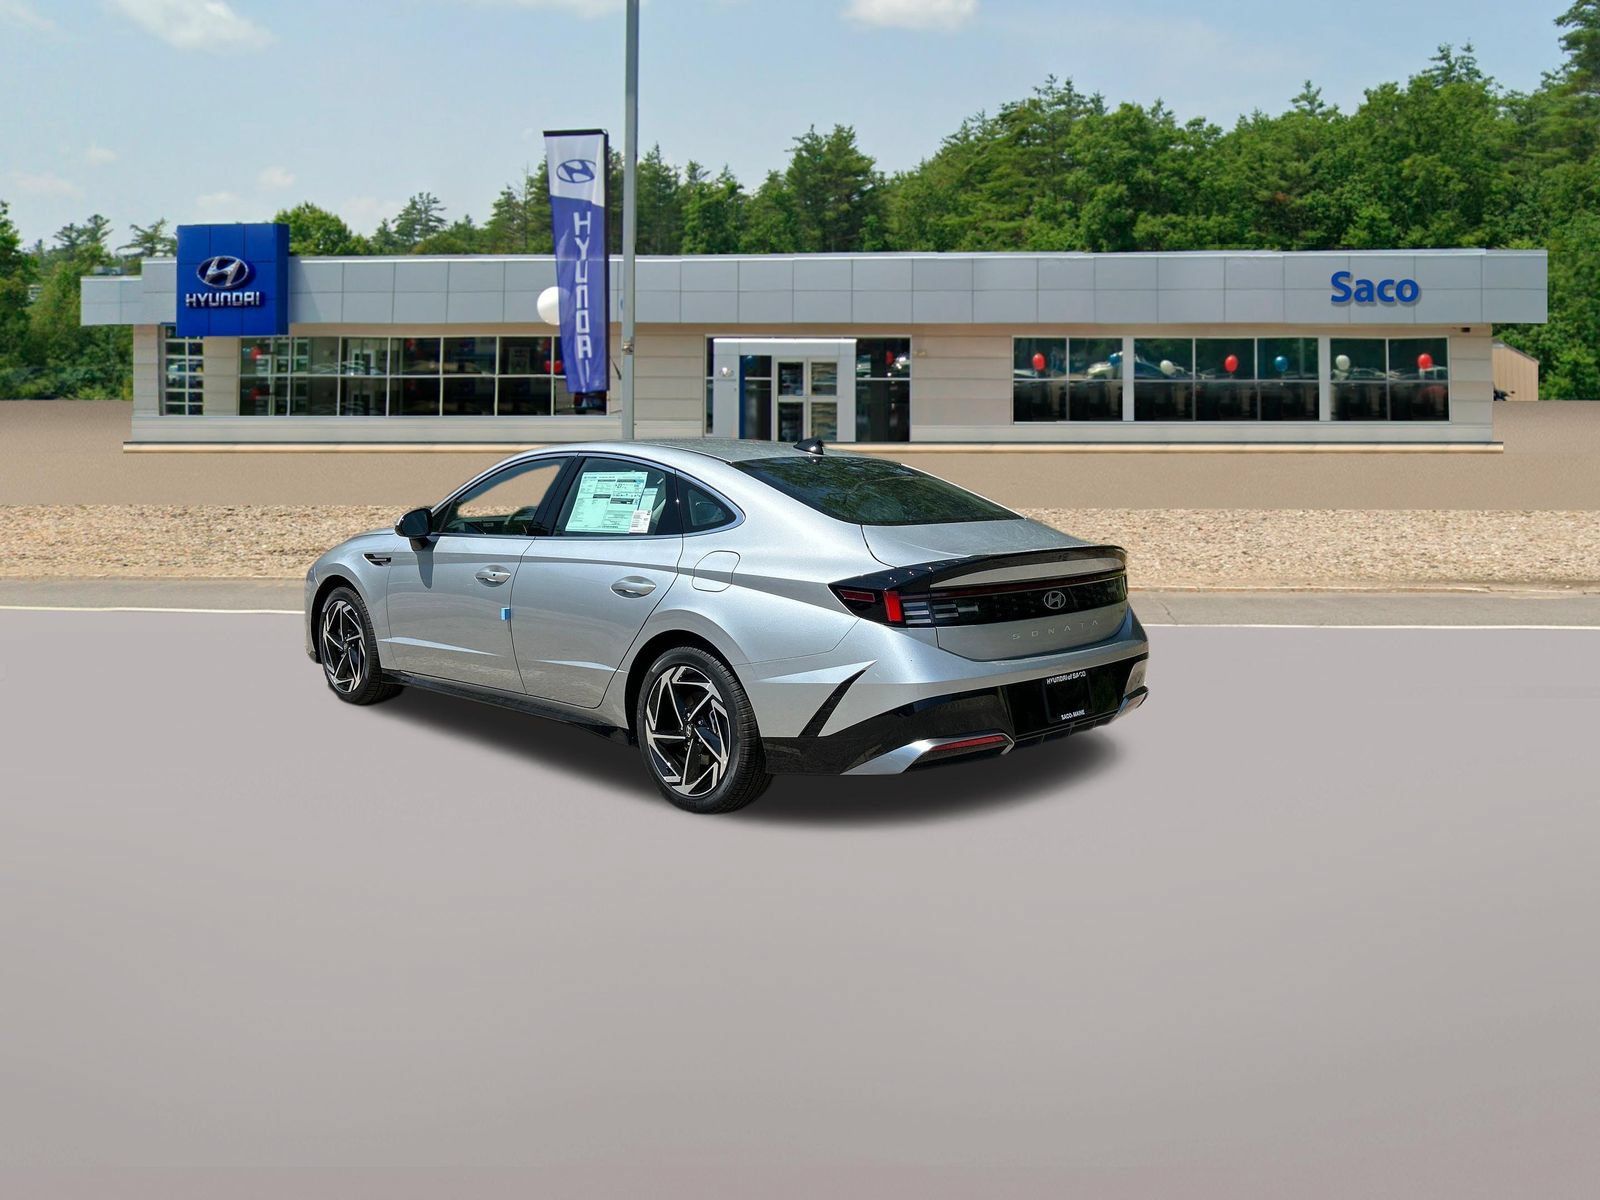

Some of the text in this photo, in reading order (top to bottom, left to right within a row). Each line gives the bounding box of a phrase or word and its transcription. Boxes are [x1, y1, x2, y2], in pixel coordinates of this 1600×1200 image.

[185, 291, 260, 308] HYUNDAI
[573, 211, 592, 383] HYUNDAI
[1331, 271, 1419, 303] Saco
[1012, 620, 1098, 640] SONATA
